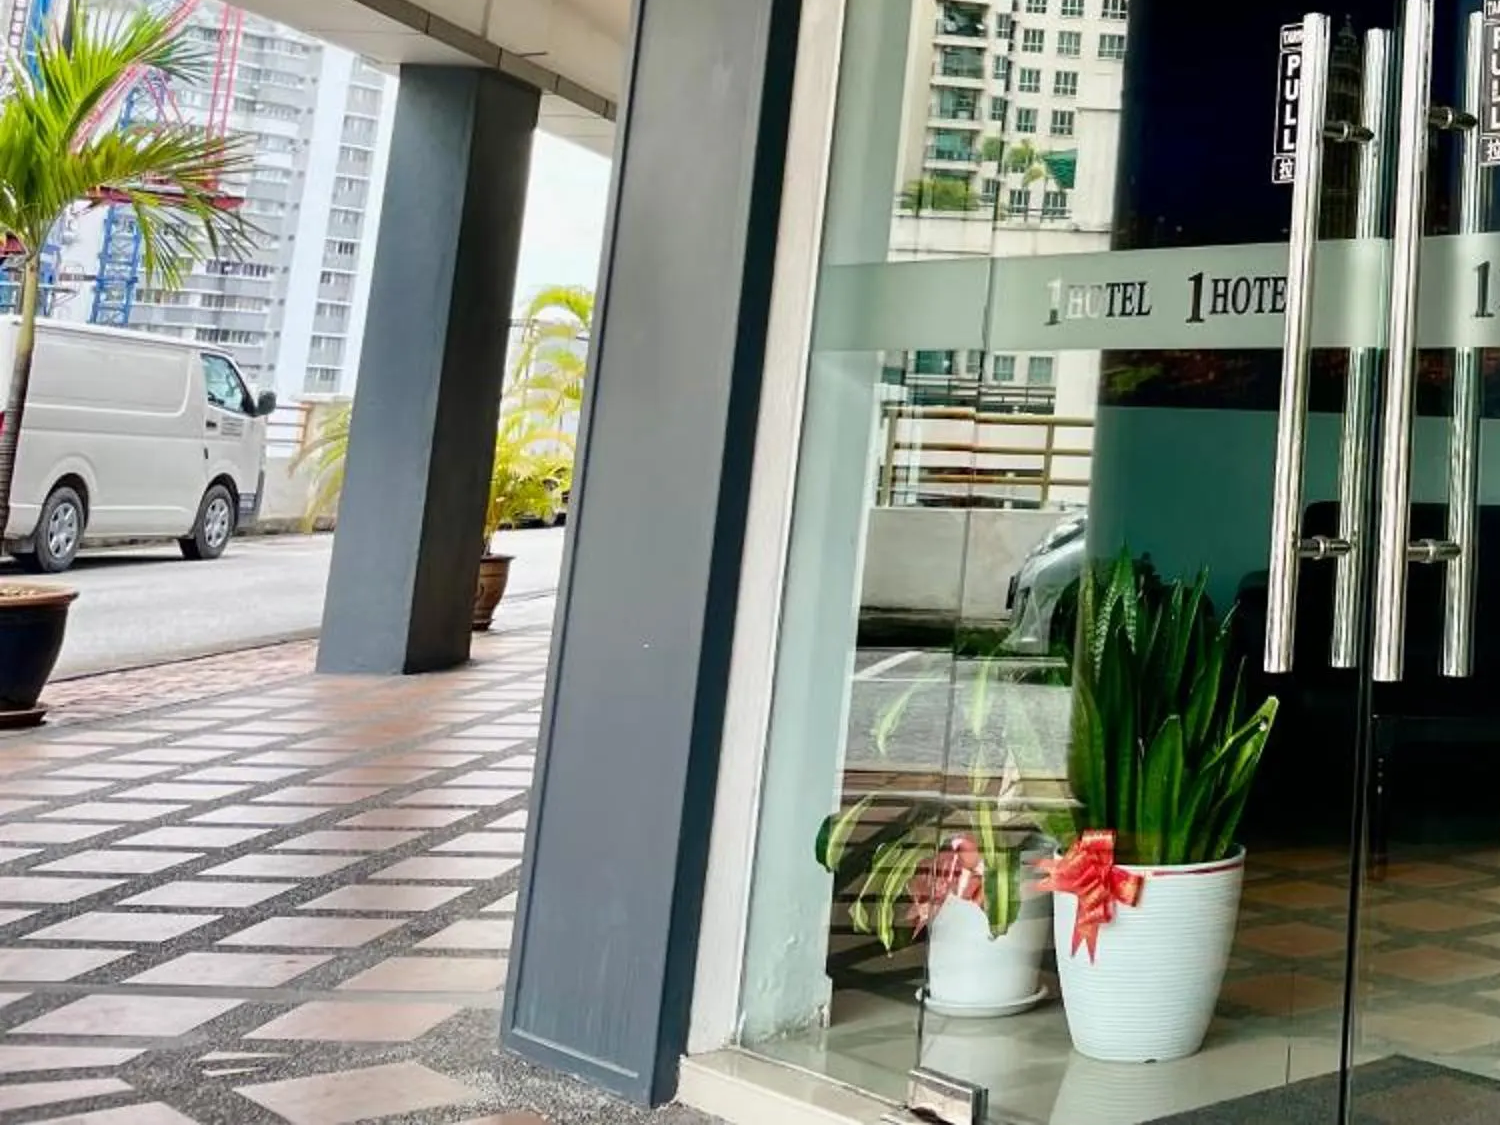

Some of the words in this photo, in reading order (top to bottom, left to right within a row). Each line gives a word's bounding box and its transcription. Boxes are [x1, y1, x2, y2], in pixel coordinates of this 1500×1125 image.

[1283, 55, 1300, 150] PULL
[1044, 277, 1061, 326] 1
[1065, 281, 1152, 318] HOTEL
[1185, 272, 1205, 323] 1
[1209, 277, 1287, 316] HOTE
[1473, 260, 1495, 318] 1
